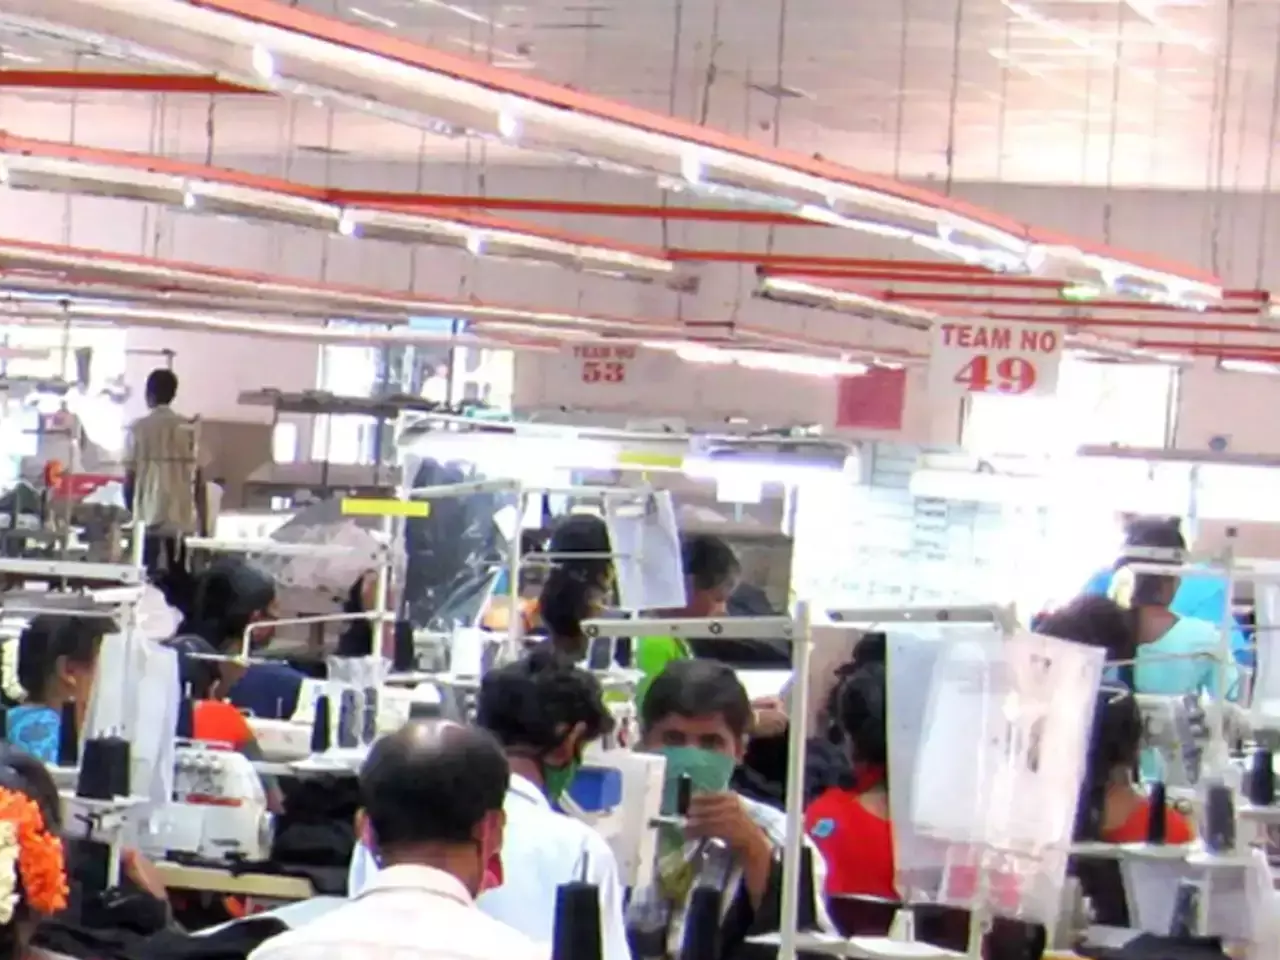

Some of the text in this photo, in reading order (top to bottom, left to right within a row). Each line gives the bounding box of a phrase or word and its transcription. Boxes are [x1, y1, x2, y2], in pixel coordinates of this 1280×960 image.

[940, 323, 1057, 353] TEAM NO
[582, 361, 625, 384] 53
[953, 354, 1037, 394] 49
